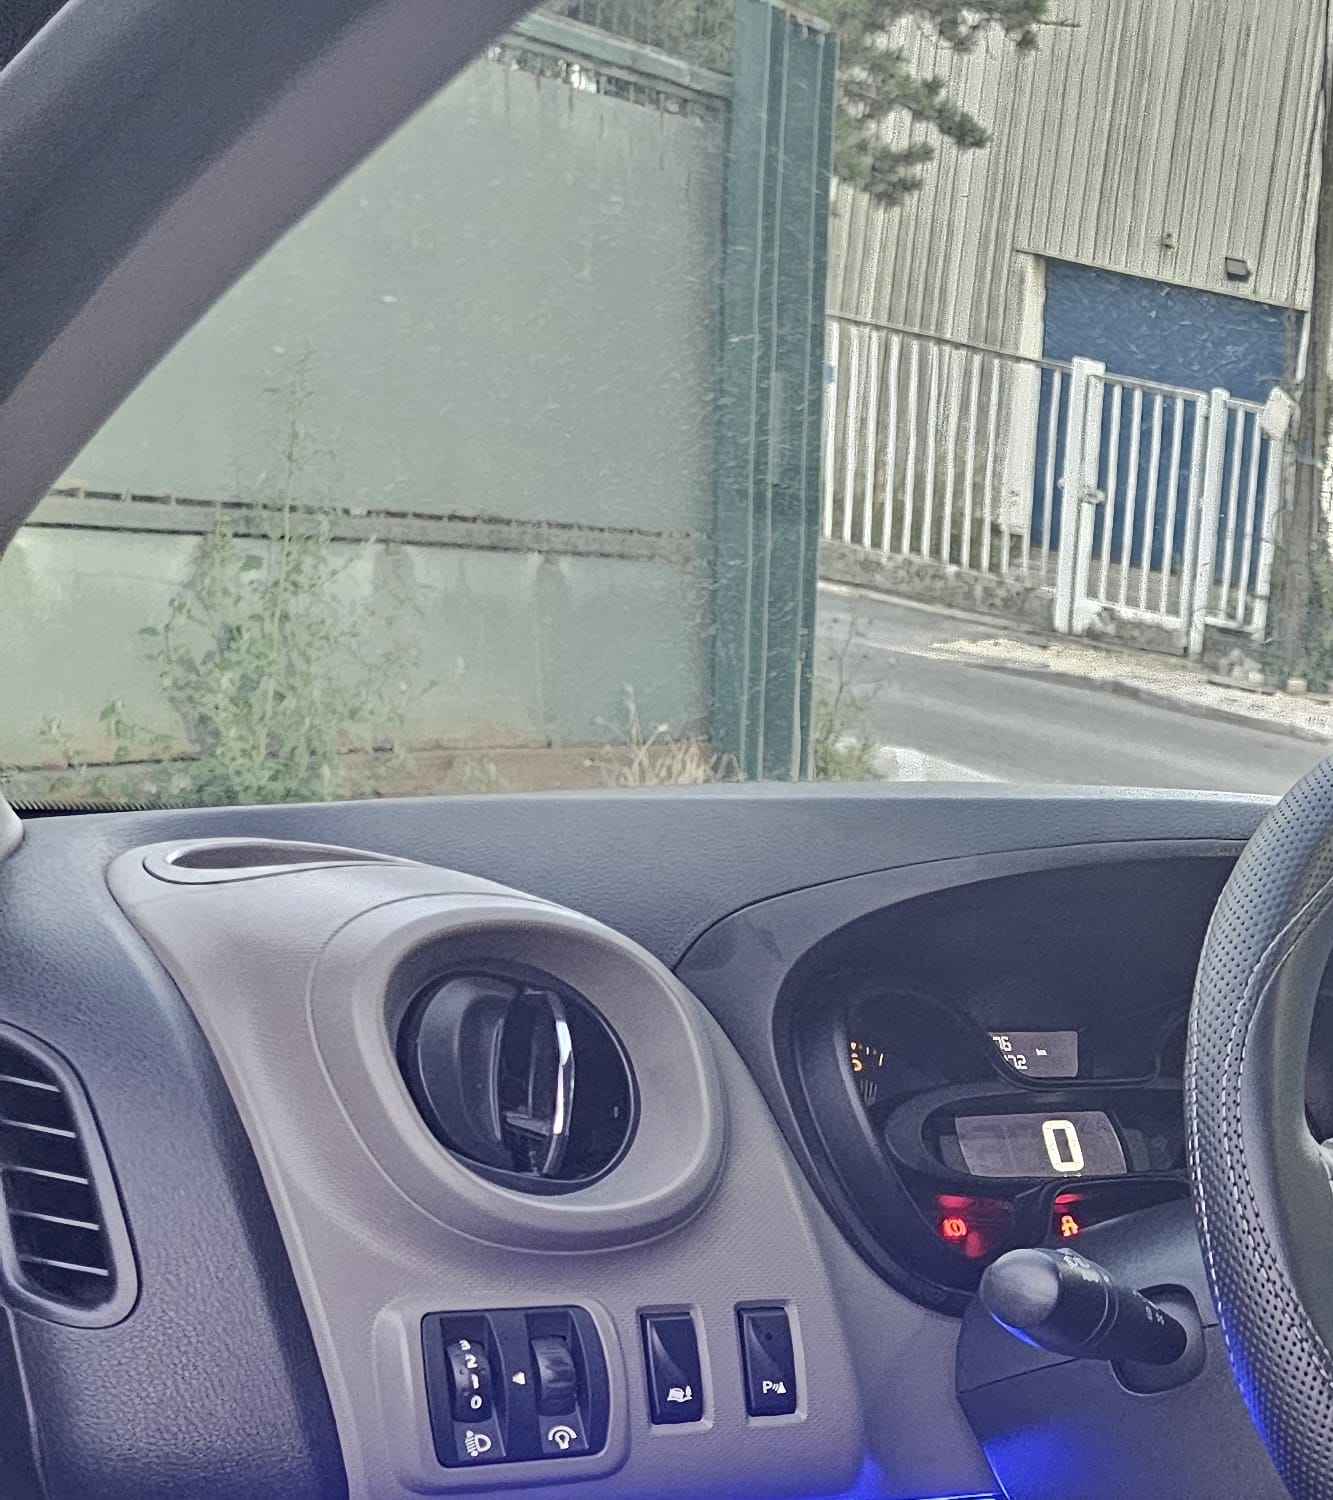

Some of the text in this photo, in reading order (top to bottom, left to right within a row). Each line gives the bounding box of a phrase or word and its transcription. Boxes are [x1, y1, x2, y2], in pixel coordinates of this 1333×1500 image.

[1042, 1119, 1085, 1173] 0
[465, 1353, 478, 1369] 2
[471, 1373, 479, 1389] 1
[470, 1395, 482, 1409] 0
